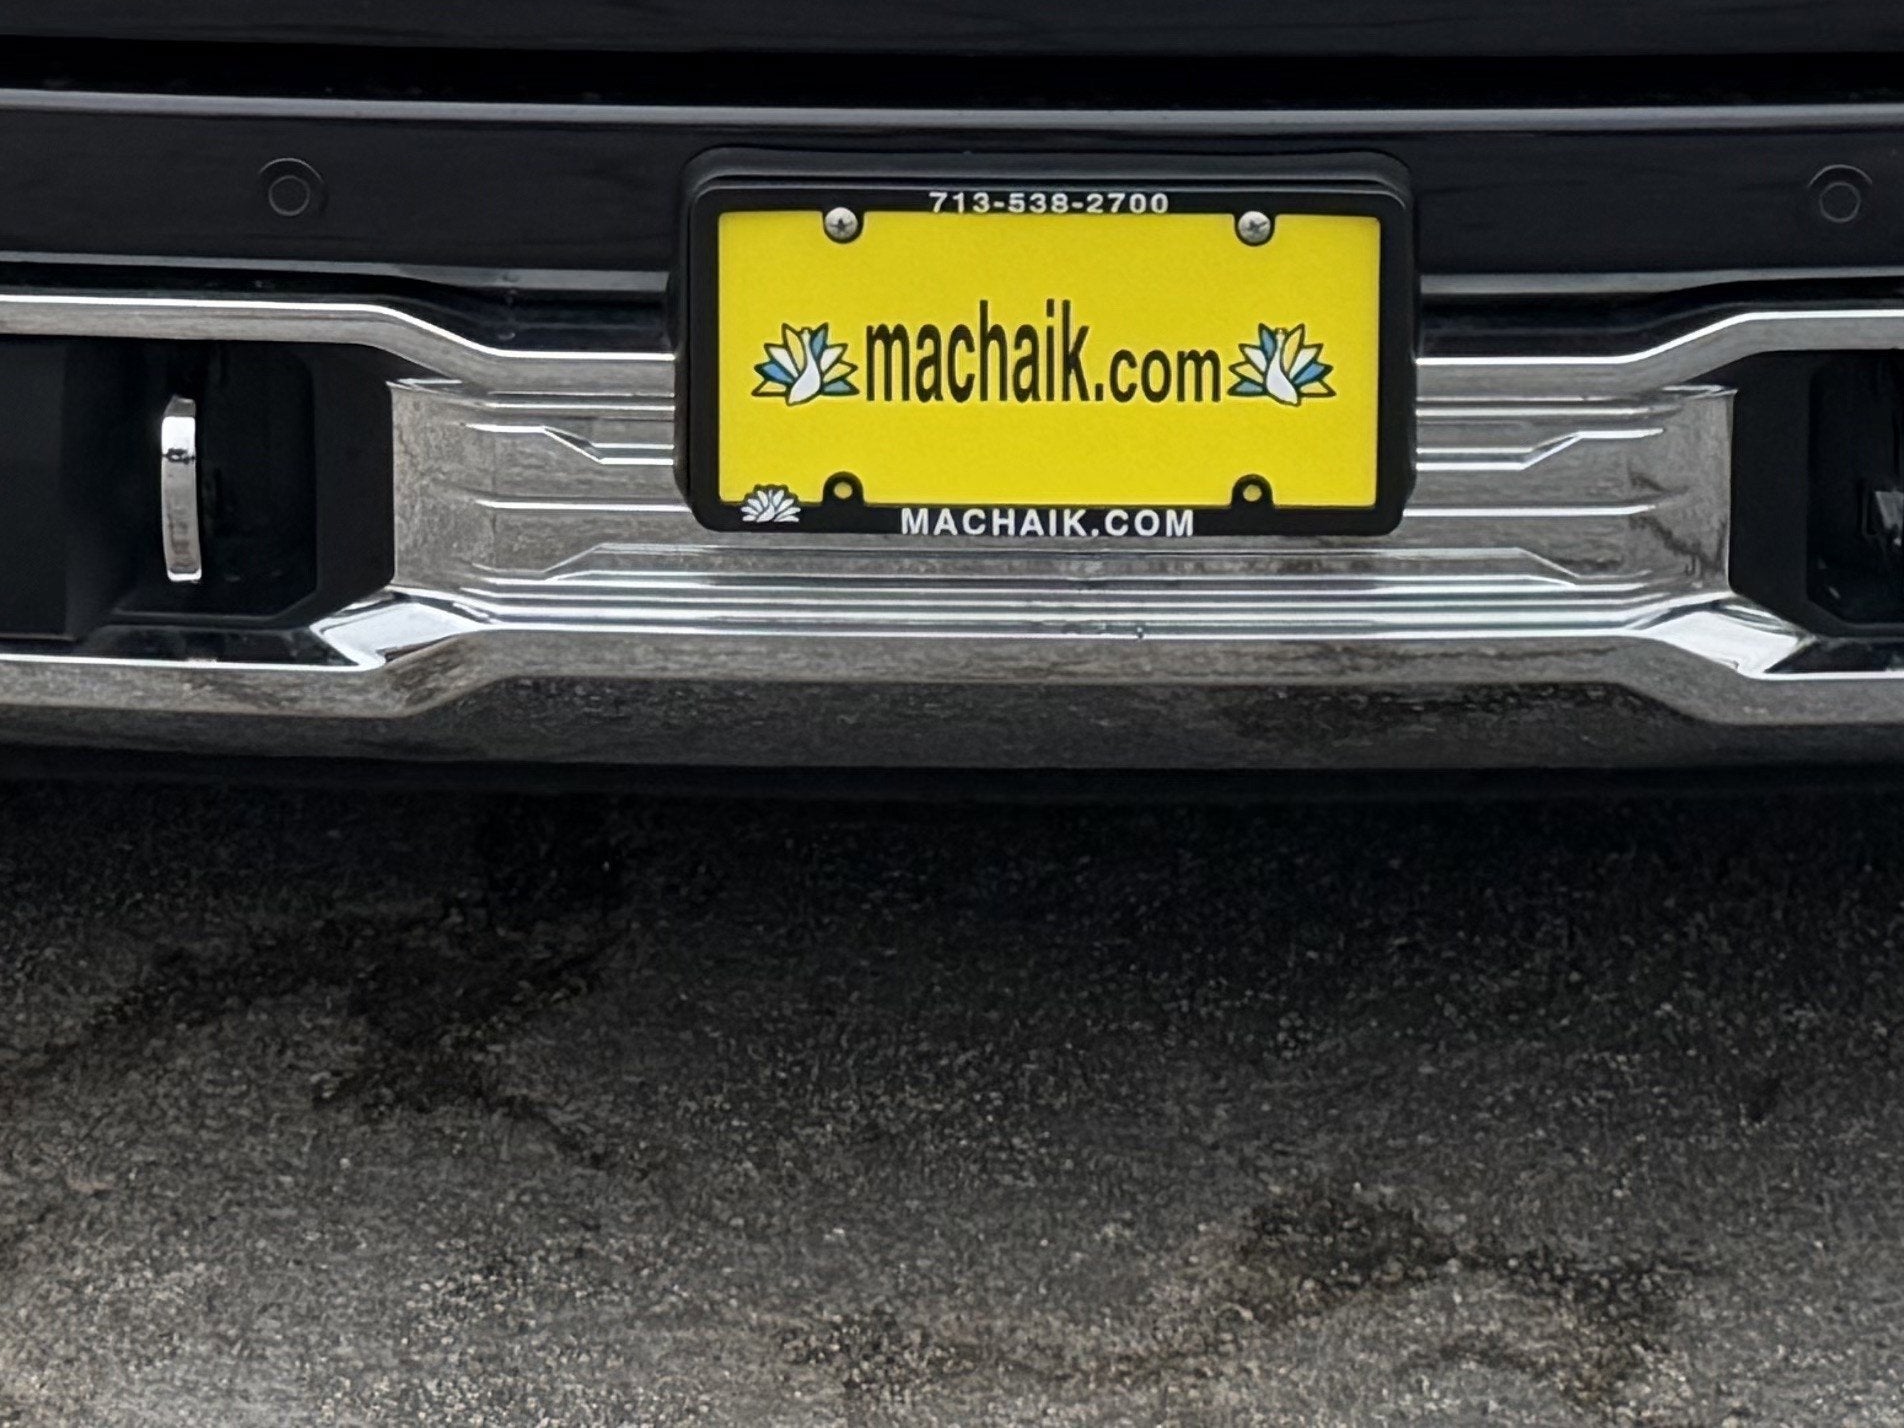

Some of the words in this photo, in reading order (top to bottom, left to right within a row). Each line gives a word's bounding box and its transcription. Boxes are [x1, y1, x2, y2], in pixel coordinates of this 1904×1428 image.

[928, 191, 1170, 215] 713-538-2700
[865, 297, 1223, 403] machaik.com
[899, 506, 1195, 539] MACHAIK.COM
